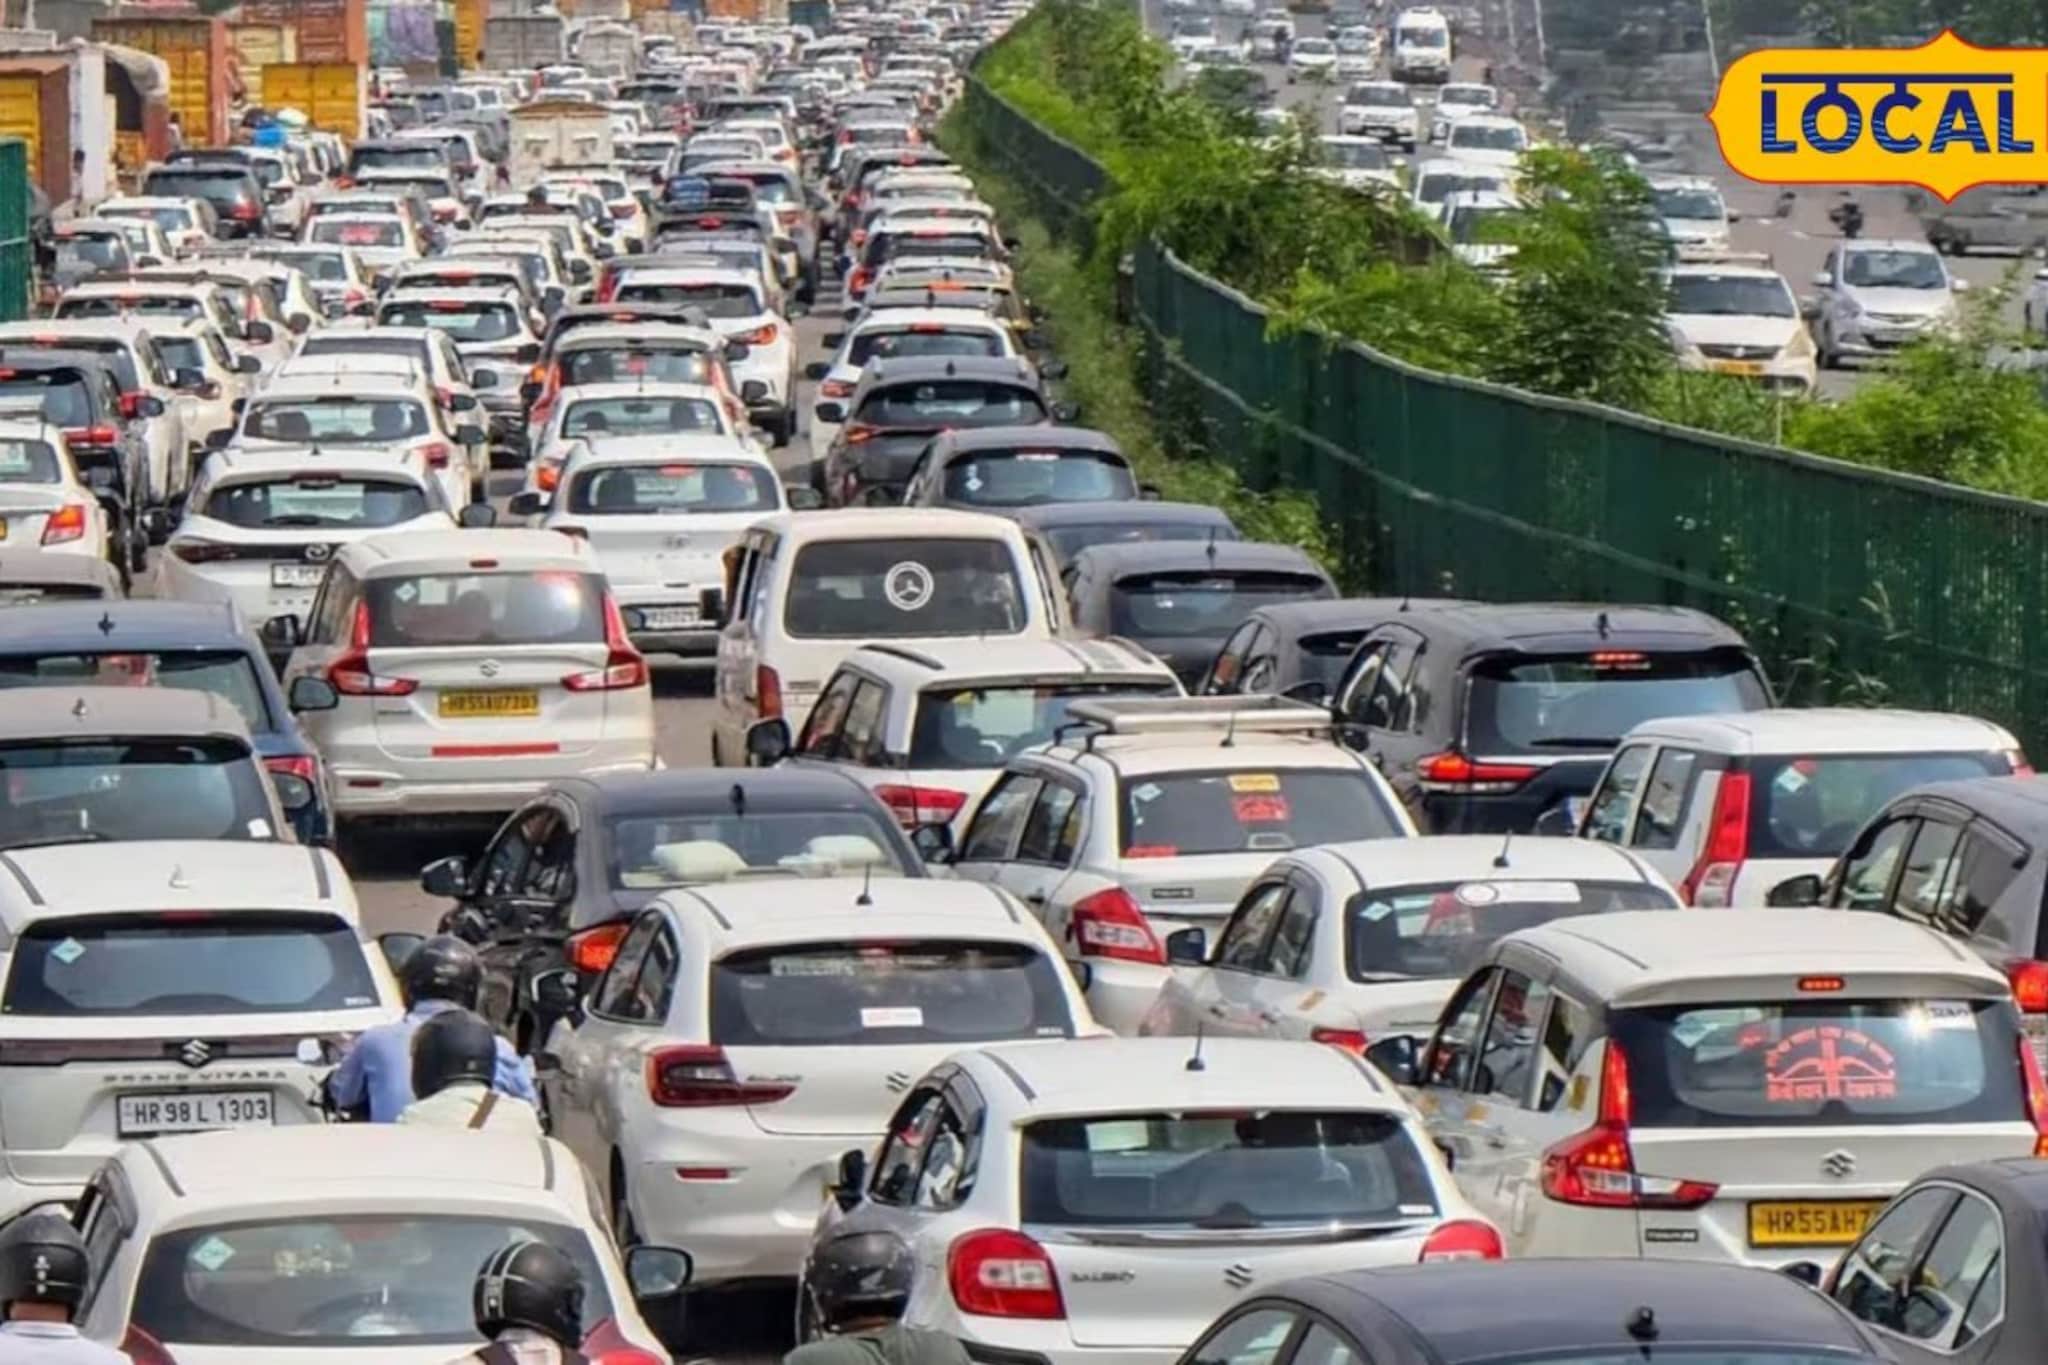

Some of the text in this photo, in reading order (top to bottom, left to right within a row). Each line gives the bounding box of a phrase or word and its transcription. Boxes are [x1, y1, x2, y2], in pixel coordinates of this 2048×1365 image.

[200, 1070, 287, 1080] VITARA
[134, 1099, 268, 1125] HR 98 L 1303
